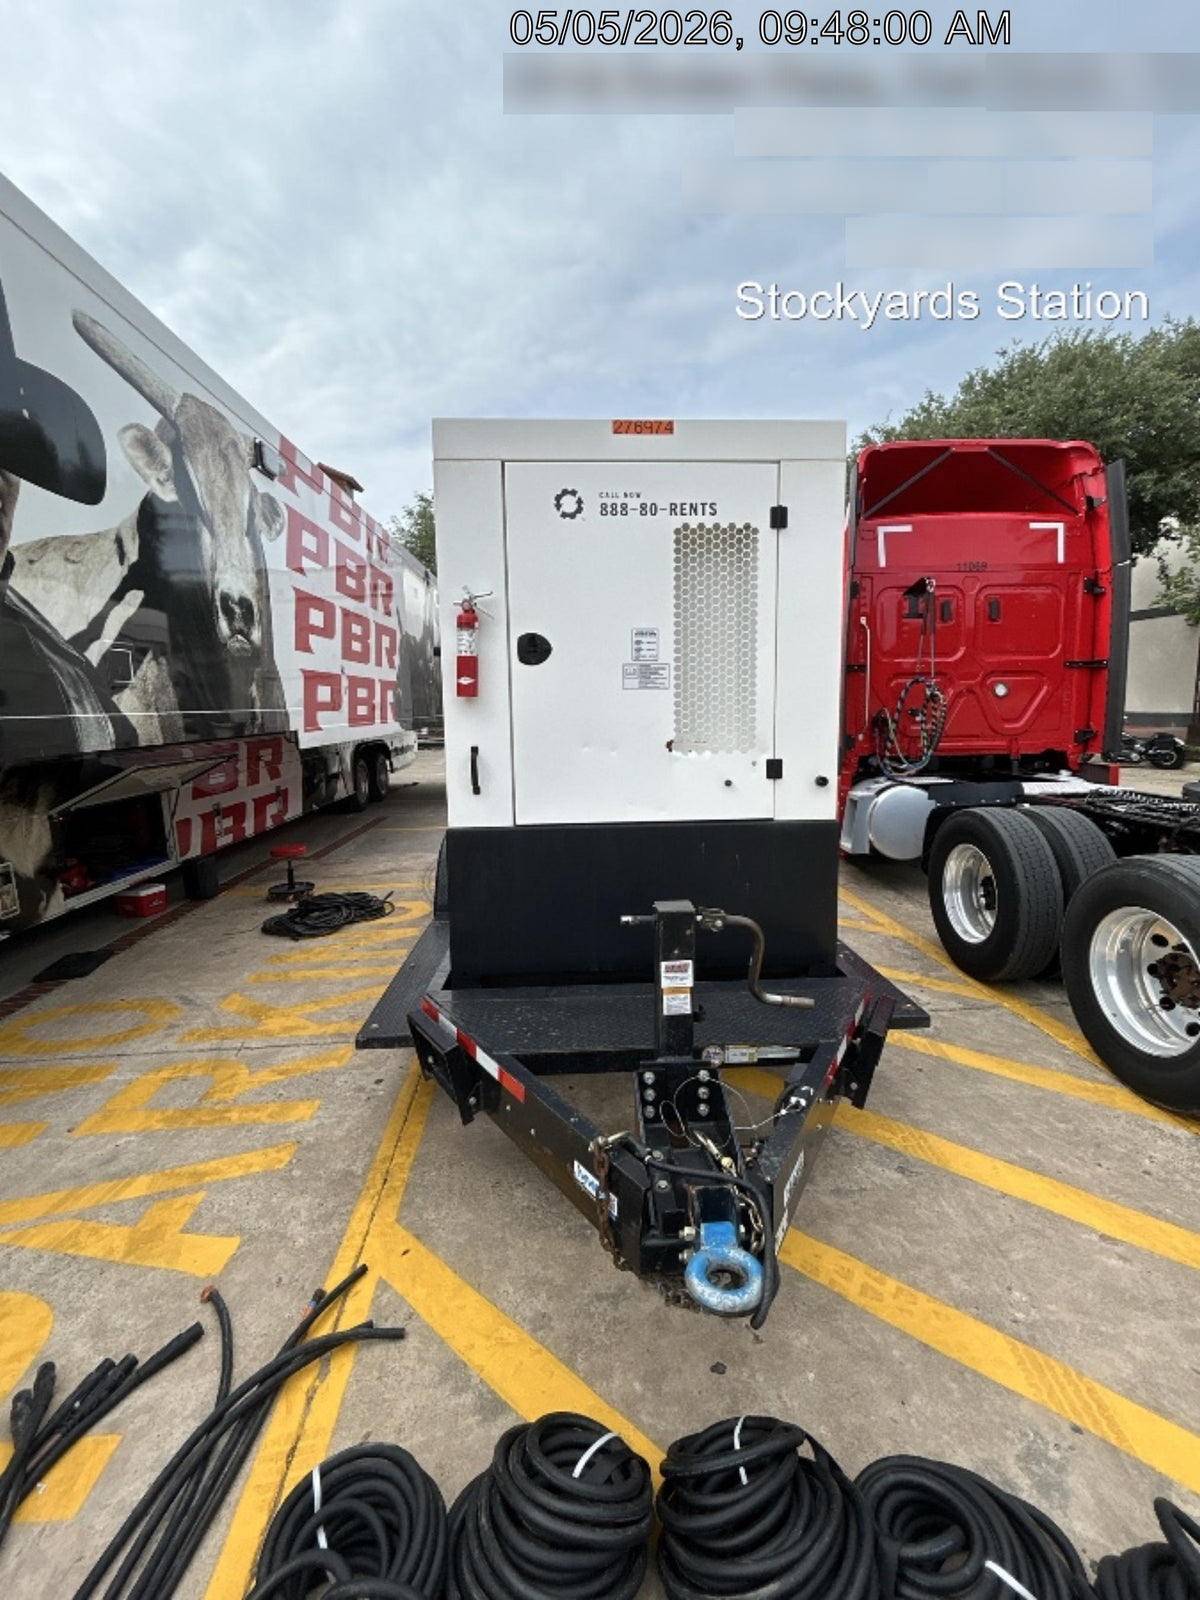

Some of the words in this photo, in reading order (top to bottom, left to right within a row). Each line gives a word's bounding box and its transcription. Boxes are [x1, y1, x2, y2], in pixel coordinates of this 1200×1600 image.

[613, 420, 674, 434] 276974
[599, 491, 620, 499] CALL
[599, 502, 718, 517] 888-80-RENTS
[283, 501, 394, 618] PBR
[292, 584, 398, 669] PBR
[299, 668, 400, 734] PBR
[176, 787, 289, 858] BR
